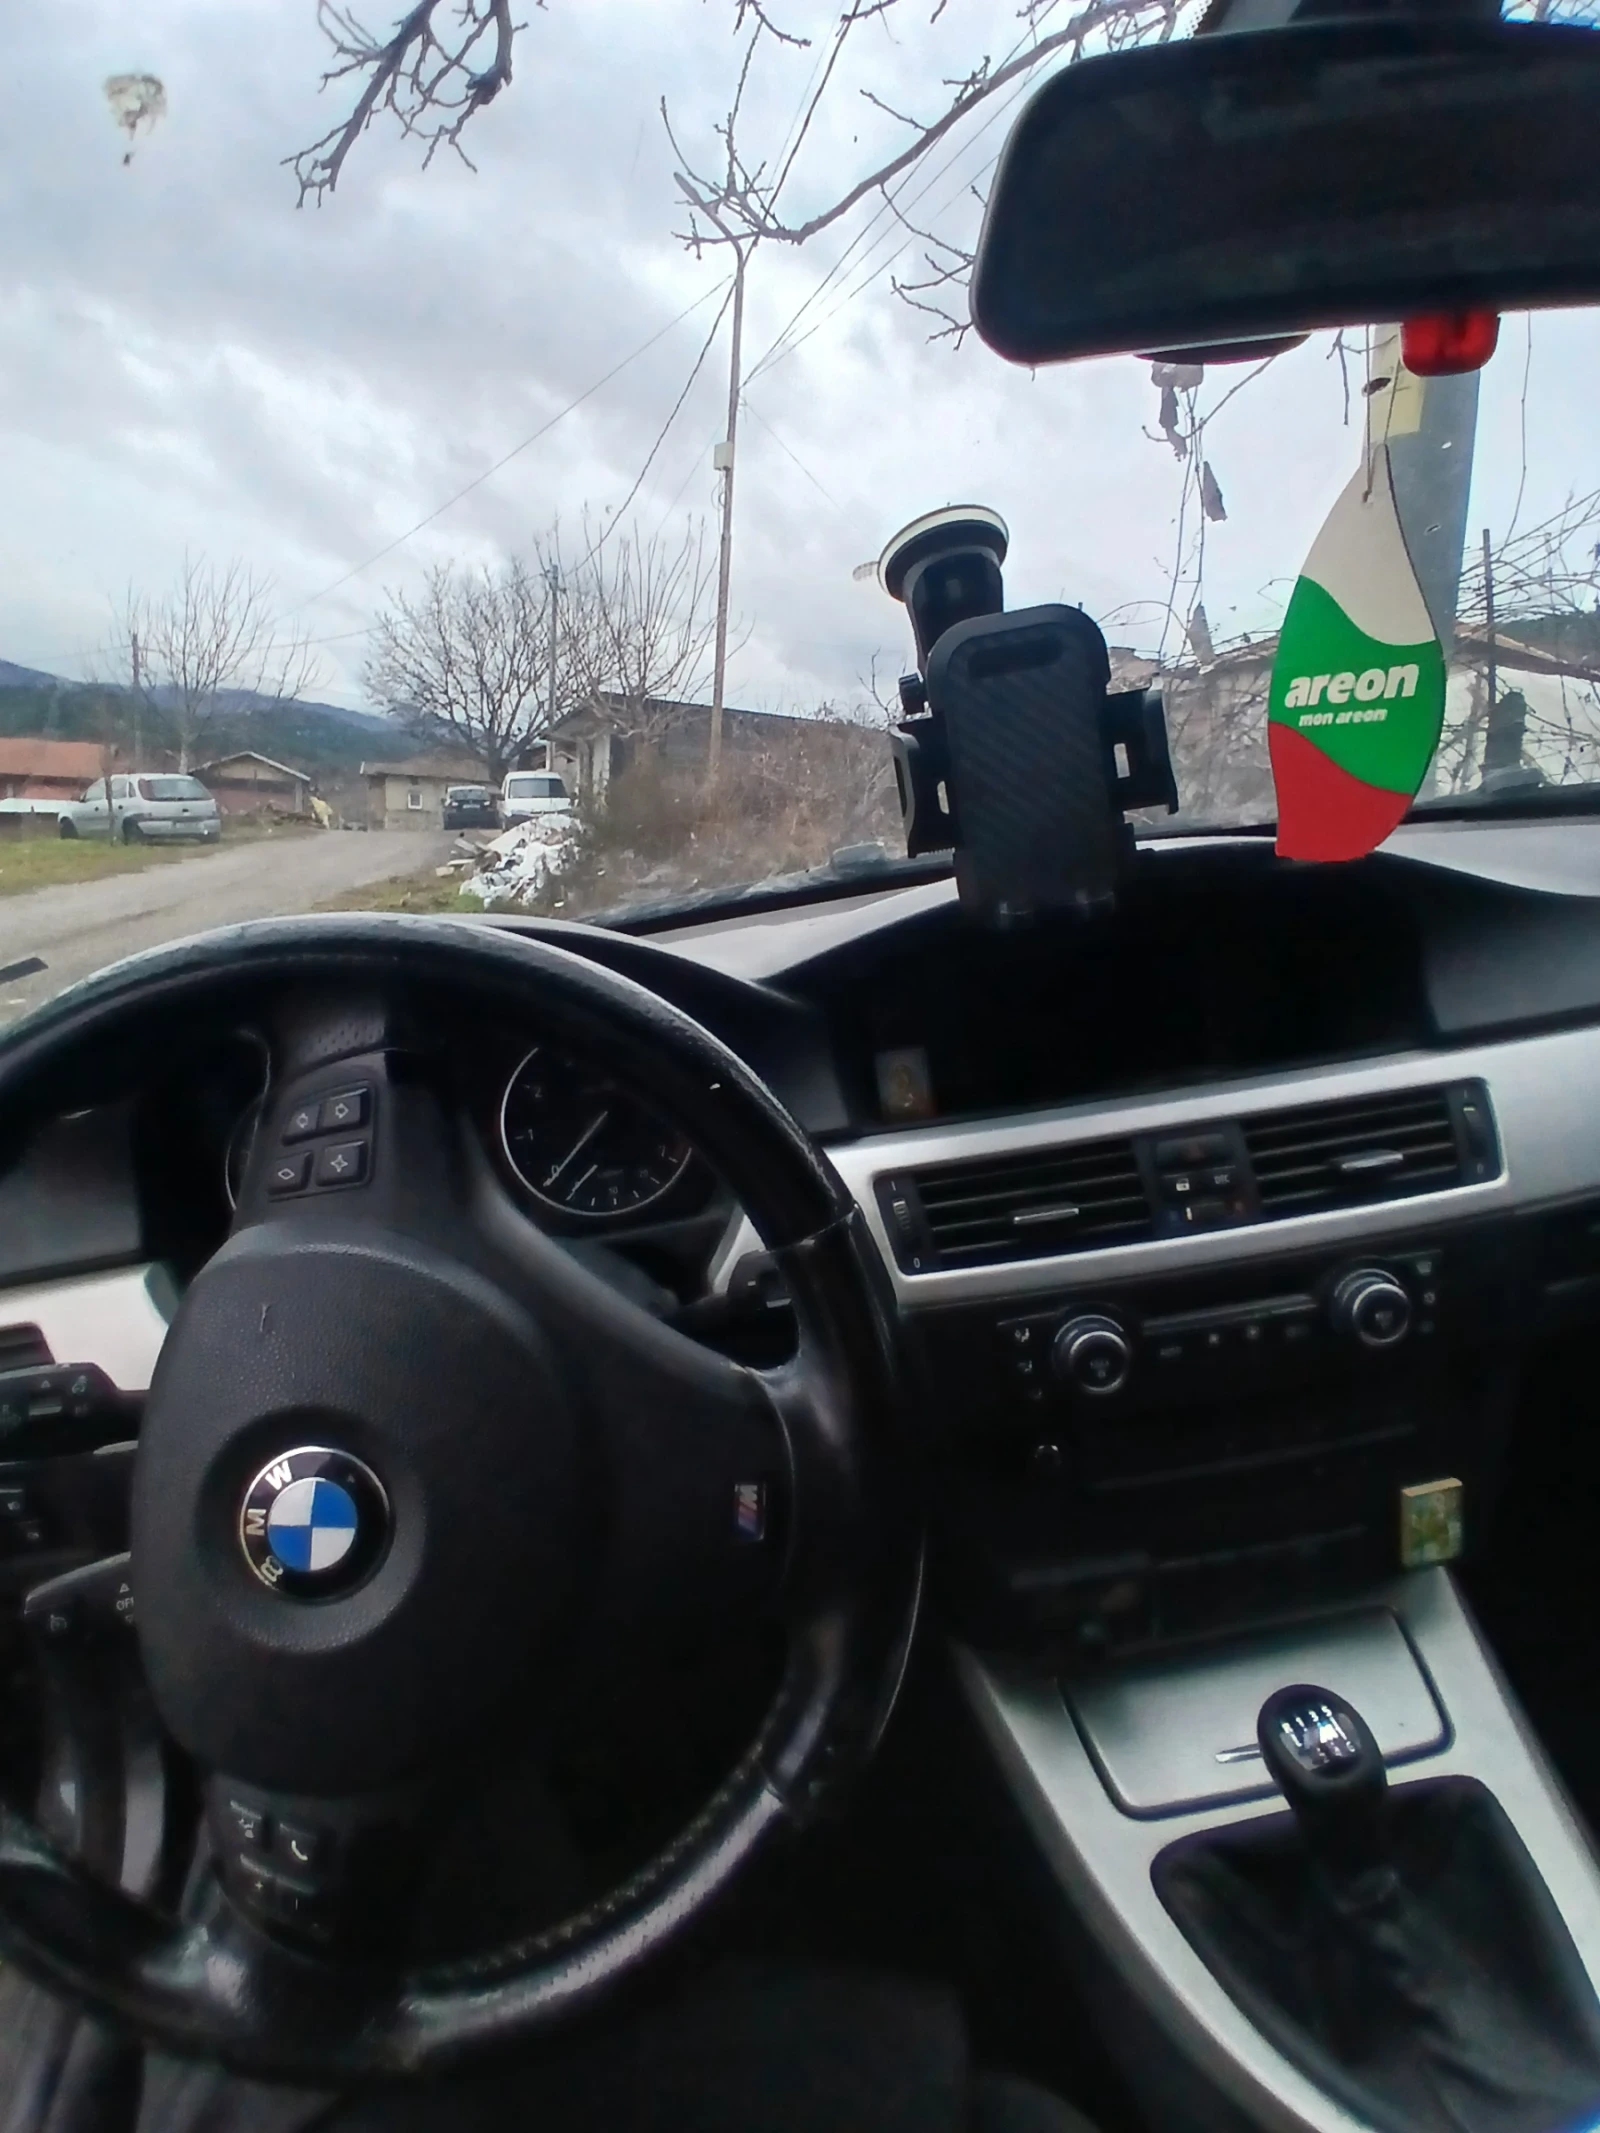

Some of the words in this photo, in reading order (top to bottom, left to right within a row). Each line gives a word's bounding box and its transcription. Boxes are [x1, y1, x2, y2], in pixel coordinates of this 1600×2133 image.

[1284, 663, 1420, 708] areon
[1299, 712, 1334, 727] mon
[1335, 709, 1388, 725] areon
[1308, 1710, 1319, 1722] 3
